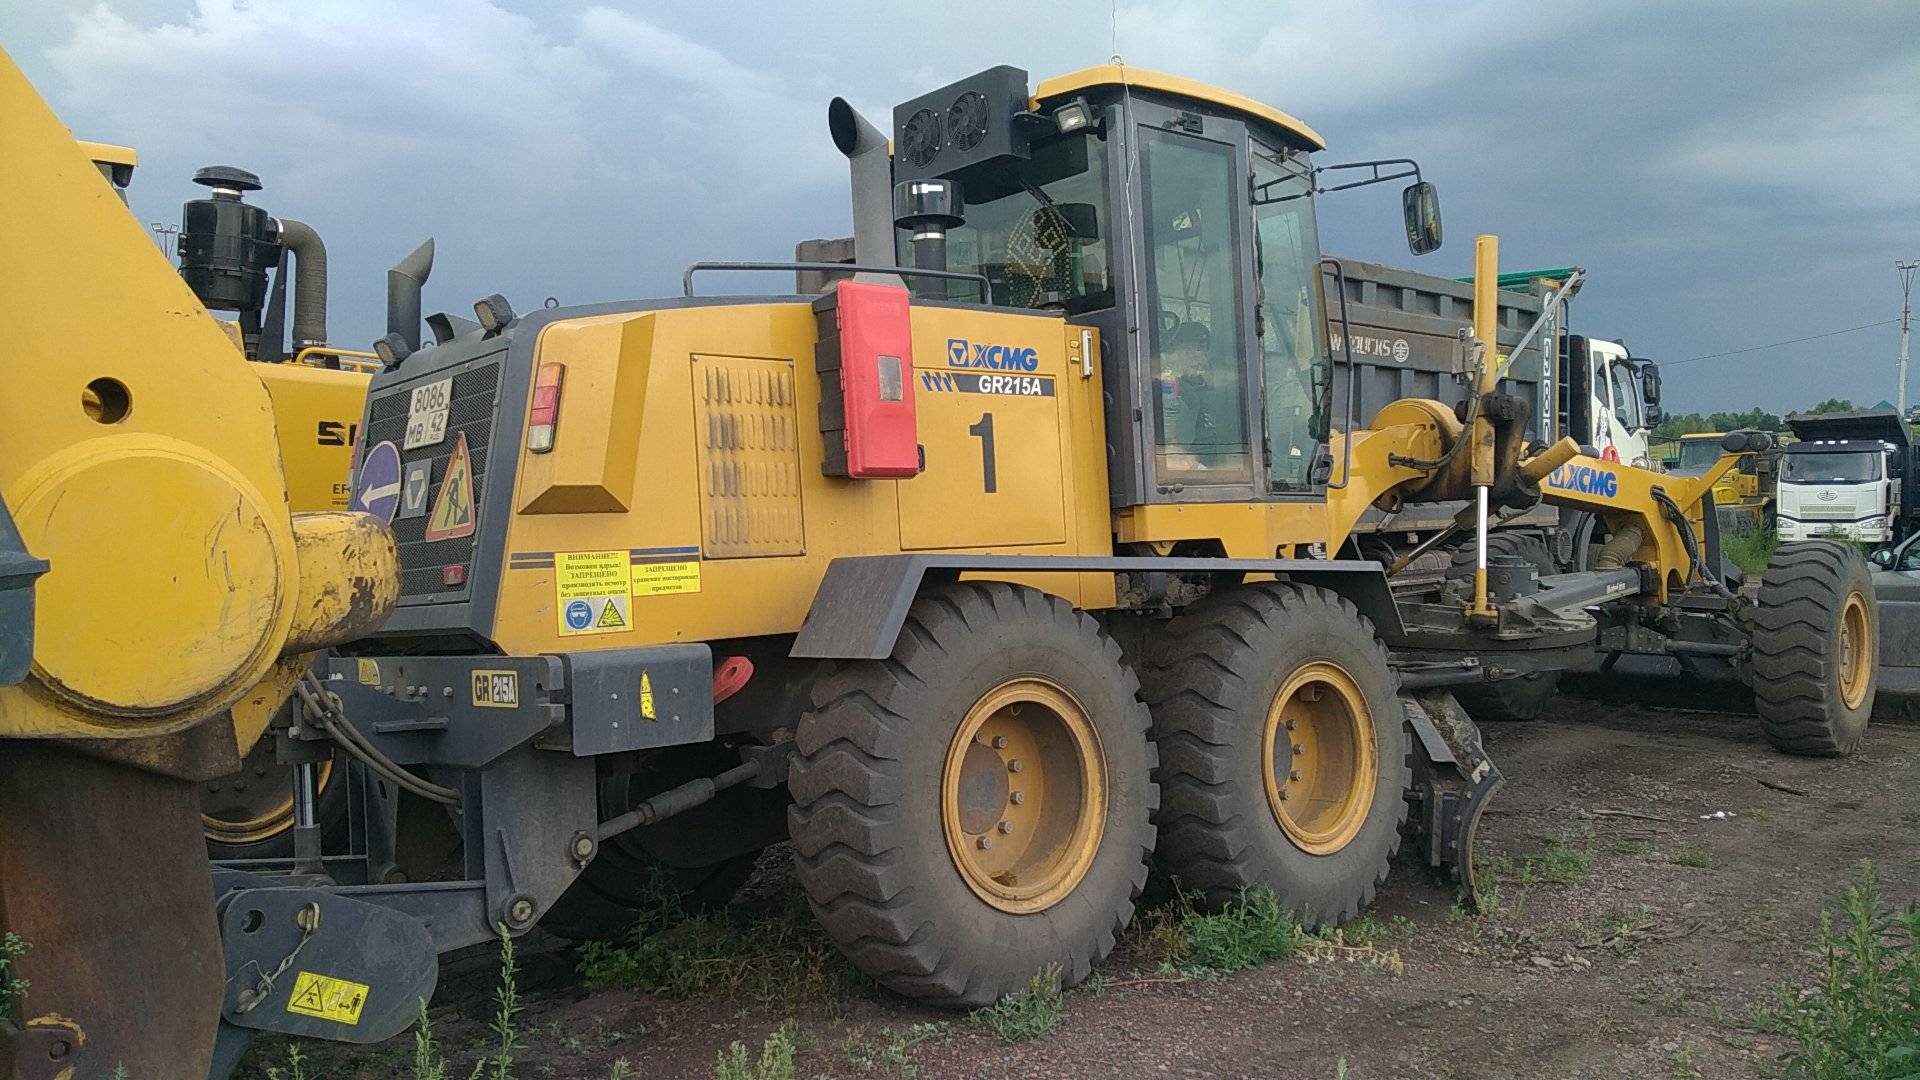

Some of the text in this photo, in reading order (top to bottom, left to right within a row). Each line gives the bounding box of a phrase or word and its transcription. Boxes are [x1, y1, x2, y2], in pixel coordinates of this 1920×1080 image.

[971, 344, 1039, 371] XCMG
[1349, 335, 1391, 356] RUCKS
[978, 375, 1042, 395] GR215A
[414, 382, 445, 413] 8086
[431, 412, 444, 430] 42
[969, 412, 997, 493] 1
[1564, 463, 1618, 498] XCMG
[571, 570, 618, 580] ЗАПРЕЩЕНО
[645, 564, 688, 573] ЗАПРЕЩЕНО
[474, 675, 516, 704] GR 215A
